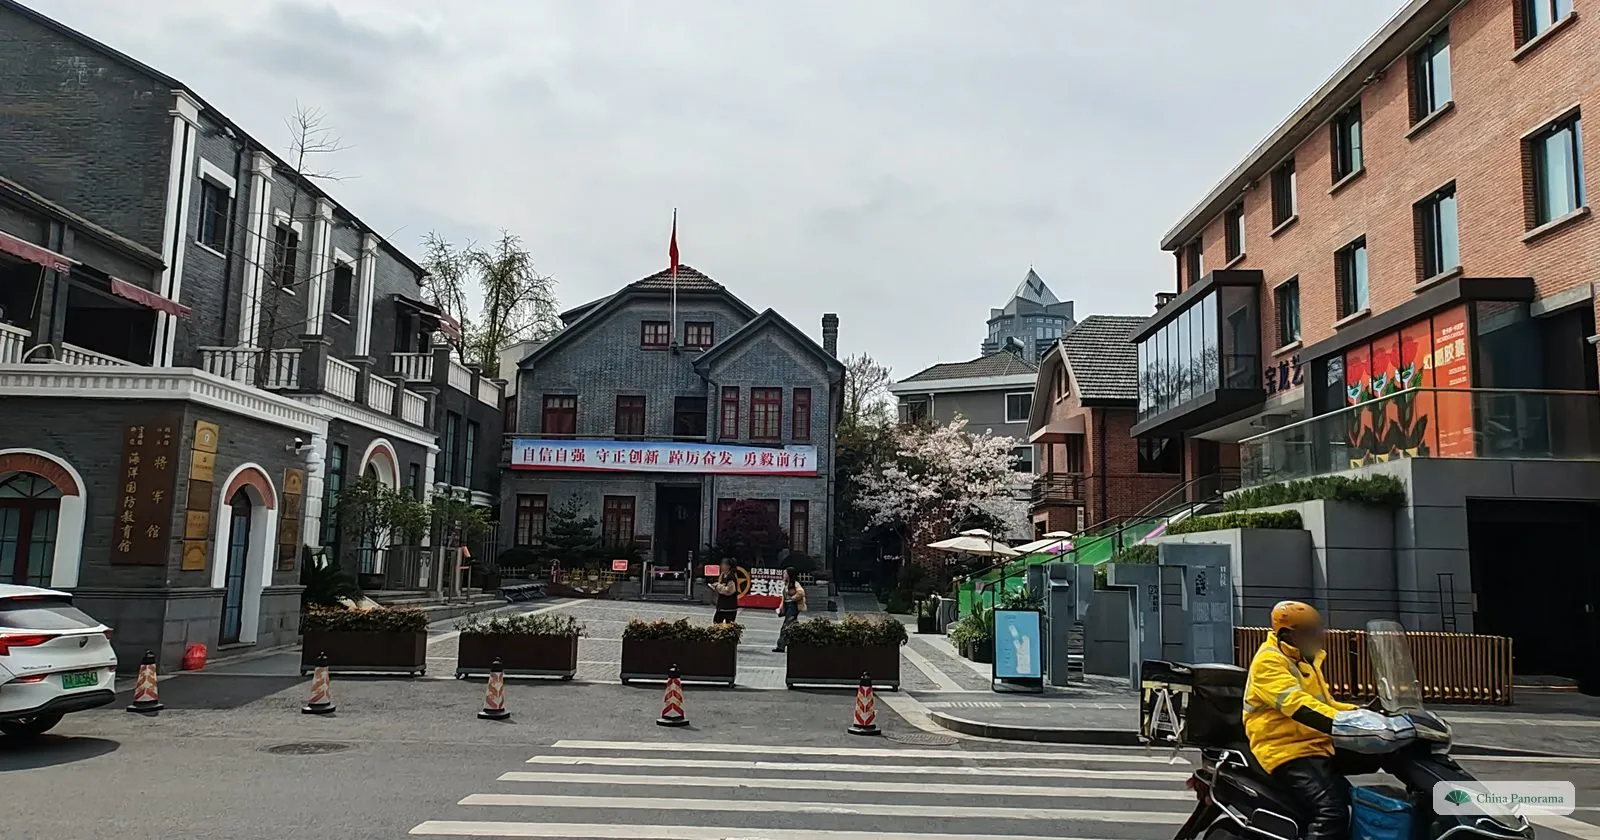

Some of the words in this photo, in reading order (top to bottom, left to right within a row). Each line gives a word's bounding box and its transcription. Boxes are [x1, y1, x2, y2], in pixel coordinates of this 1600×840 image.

[523, 446, 586, 463] 自信自强
[596, 448, 659, 465] 守正创新
[668, 450, 733, 466] 踔厉奋发
[744, 451, 807, 468] 勇毅前行
[750, 578, 784, 598] 英雄
